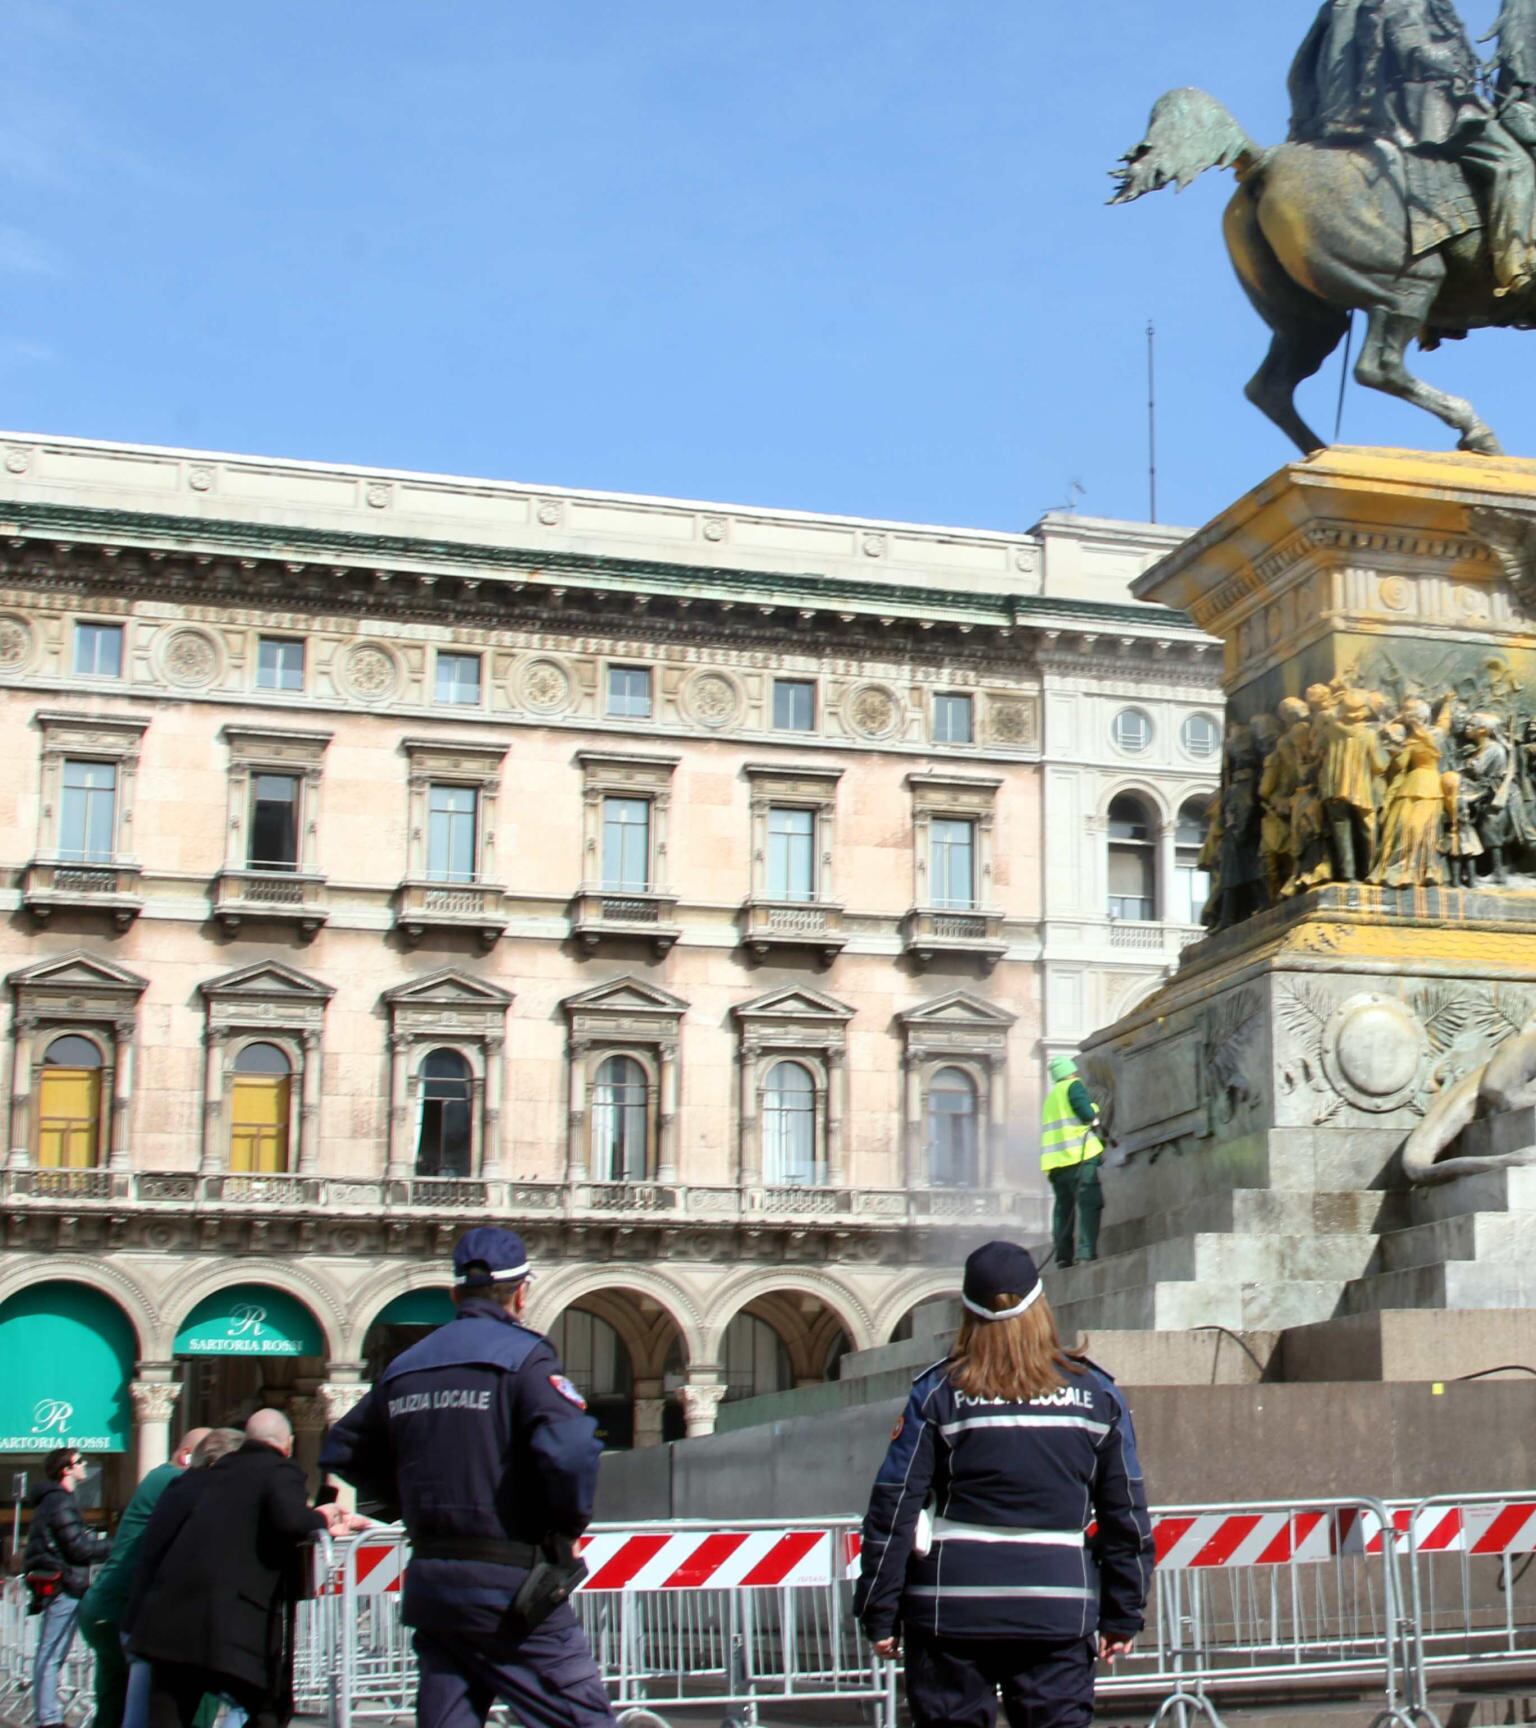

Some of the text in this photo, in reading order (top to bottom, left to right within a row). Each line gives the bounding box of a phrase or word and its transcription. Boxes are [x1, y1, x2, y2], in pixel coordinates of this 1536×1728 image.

[226, 1303, 267, 1336] R
[188, 1338, 303, 1352] SARTORIA ROSSI
[433, 1390, 491, 1410] LOCALE
[31, 1398, 74, 1433] R
[0, 1436, 111, 1449] ARTORIA ROSSI
